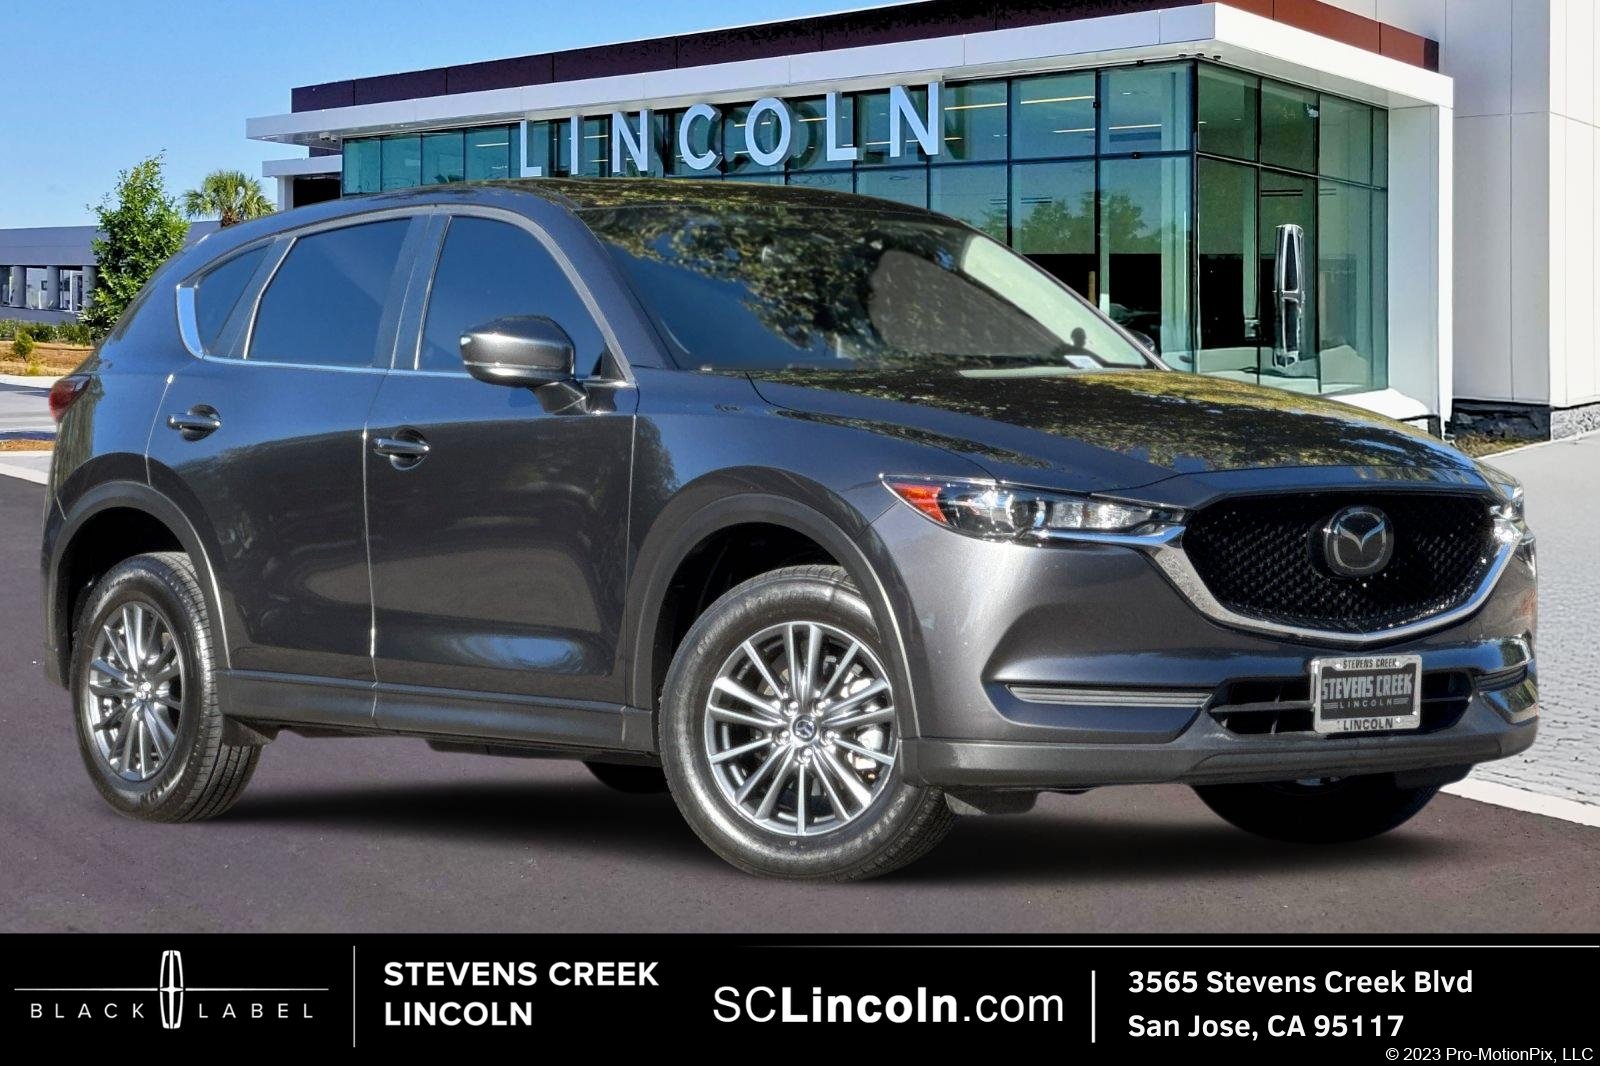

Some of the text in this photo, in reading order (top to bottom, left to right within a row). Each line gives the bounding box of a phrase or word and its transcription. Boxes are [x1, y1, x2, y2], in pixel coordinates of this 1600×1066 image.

[520, 82, 942, 178] LINCOLN
[1343, 658, 1397, 668] STEVENS CREEK
[1321, 673, 1413, 700] STEVENS CREEK
[1340, 699, 1392, 709] LINCOLN
[1343, 718, 1393, 730] LINCOLN
